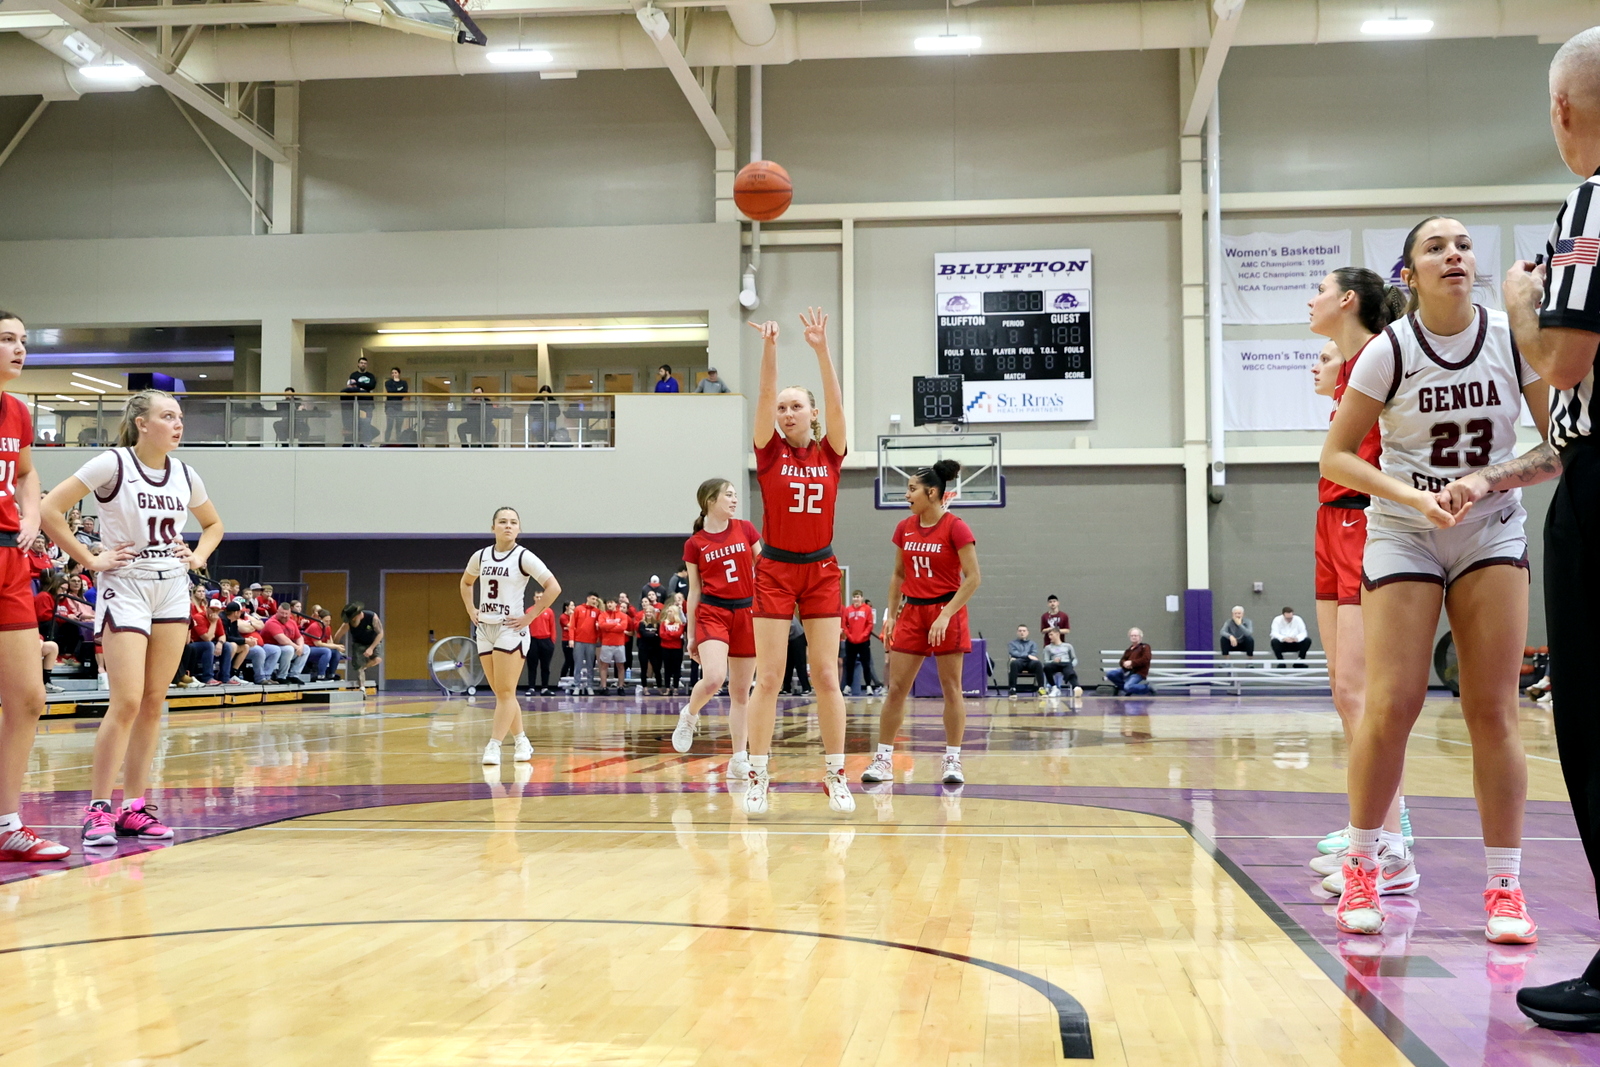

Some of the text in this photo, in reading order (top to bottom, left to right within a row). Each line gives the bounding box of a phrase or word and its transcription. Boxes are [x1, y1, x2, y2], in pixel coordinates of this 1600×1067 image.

[1225, 245, 1340, 258] Women's Basketball
[937, 260, 1089, 276] BLUFFTON
[1241, 259, 1325, 269] AMC Champions: 1995
[946, 272, 1071, 281] UNIVERSITY
[1263, 271, 1306, 280] Champions:
[1238, 284, 1260, 292] NCAA
[940, 315, 986, 327] BLUFFTON
[1002, 320, 1025, 328] PERIOD
[1050, 313, 1080, 324] GUEST
[944, 349, 964, 357] FOULS
[993, 347, 1035, 356] PLAYER FOUL
[1064, 346, 1084, 354] FOULS
[1240, 351, 1290, 361] Women's
[1004, 372, 1026, 380] MATCH
[1064, 371, 1085, 379] SCORE
[1418, 379, 1502, 413] GENOA
[1429, 416, 1494, 469] 23
[780, 464, 829, 478] BELLEVUE
[137, 492, 185, 511] GENOA
[788, 482, 824, 514] 32
[147, 516, 178, 546] 10
[704, 542, 746, 563] BELLEVUE
[904, 541, 943, 553] BELLEVUE
[481, 566, 510, 577] GENOA
[722, 559, 739, 584] 2
[911, 556, 933, 578] 14
[487, 579, 499, 600] 3
